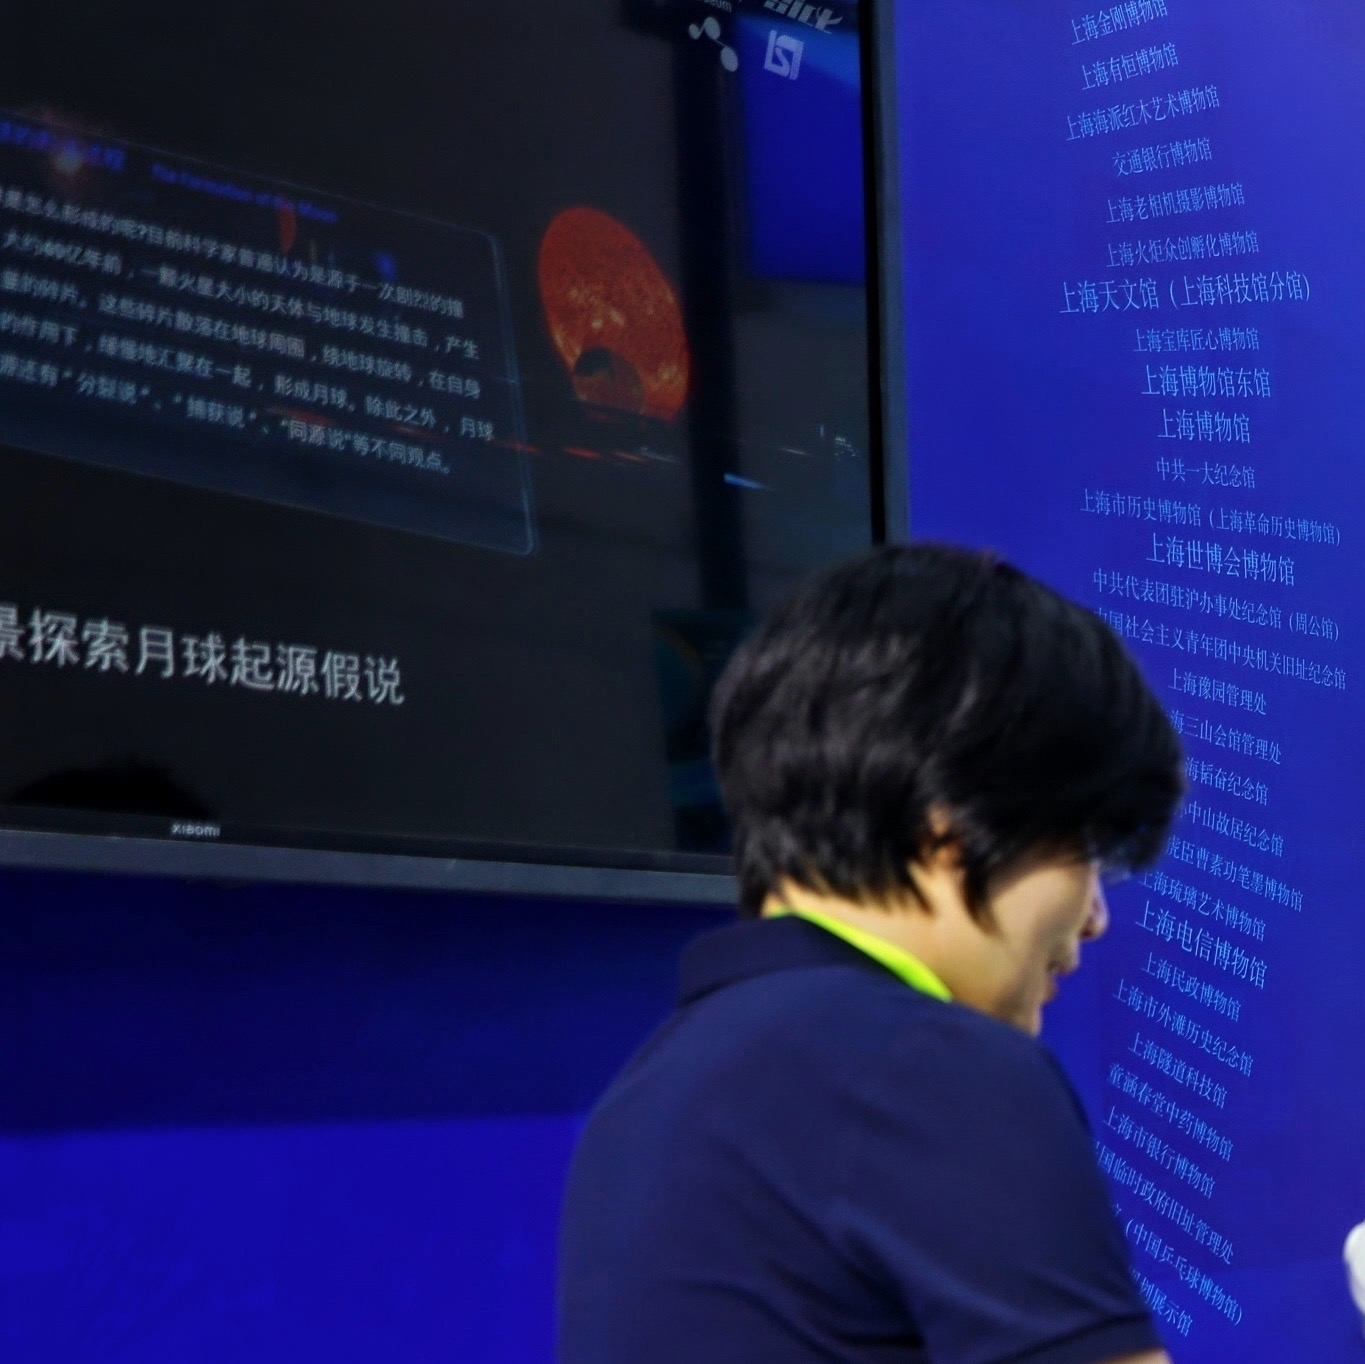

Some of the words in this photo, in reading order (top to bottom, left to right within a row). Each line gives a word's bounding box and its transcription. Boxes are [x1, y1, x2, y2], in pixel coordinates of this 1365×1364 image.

[1071, 0, 1168, 45] 上海金刚博物馆
[1081, 42, 1179, 91] 上海有恒博物馆
[1066, 85, 1220, 142] 上海海派红木艺术博物馆
[1112, 137, 1213, 178] 交通银行博物馆
[1106, 182, 1245, 224] 上海老相机摄影博物馆
[1106, 231, 1260, 268] 上海火炬众创孵化博物馆
[1133, 328, 1260, 353] 上海宝库匠心博物馆
[1141, 365, 1271, 399] 上海博物馆东馆
[1157, 408, 1251, 444] 上海博物馆
[1156, 457, 1256, 490] 中共一大纪念馆
[1146, 532, 1295, 587] 上海世博会博物馆
[0, 604, 404, 705] 景探索月球起源假说
[1168, 668, 1267, 716] 上海豫园管理处
[1166, 709, 1281, 765] 海三山会馆管理处
[1138, 869, 1266, 942] 上海琉璃艺术博物馆
[1135, 900, 1267, 990] 上海电信博物馆
[1141, 952, 1240, 1022] 上海民政博物馆
[1113, 978, 1254, 1078] 上海市外滩历史纪念馆
[1128, 1031, 1228, 1110] 上海隧道科技馆
[1107, 1062, 1234, 1163] 童涵春堂中药博物馆
[1102, 1105, 1217, 1200] 上海市银行博物馆
[1094, 1141, 1234, 1266] 国临时政府旧址管理处
[1113, 1203, 1242, 1327] （中国乒乓球博物馆）
